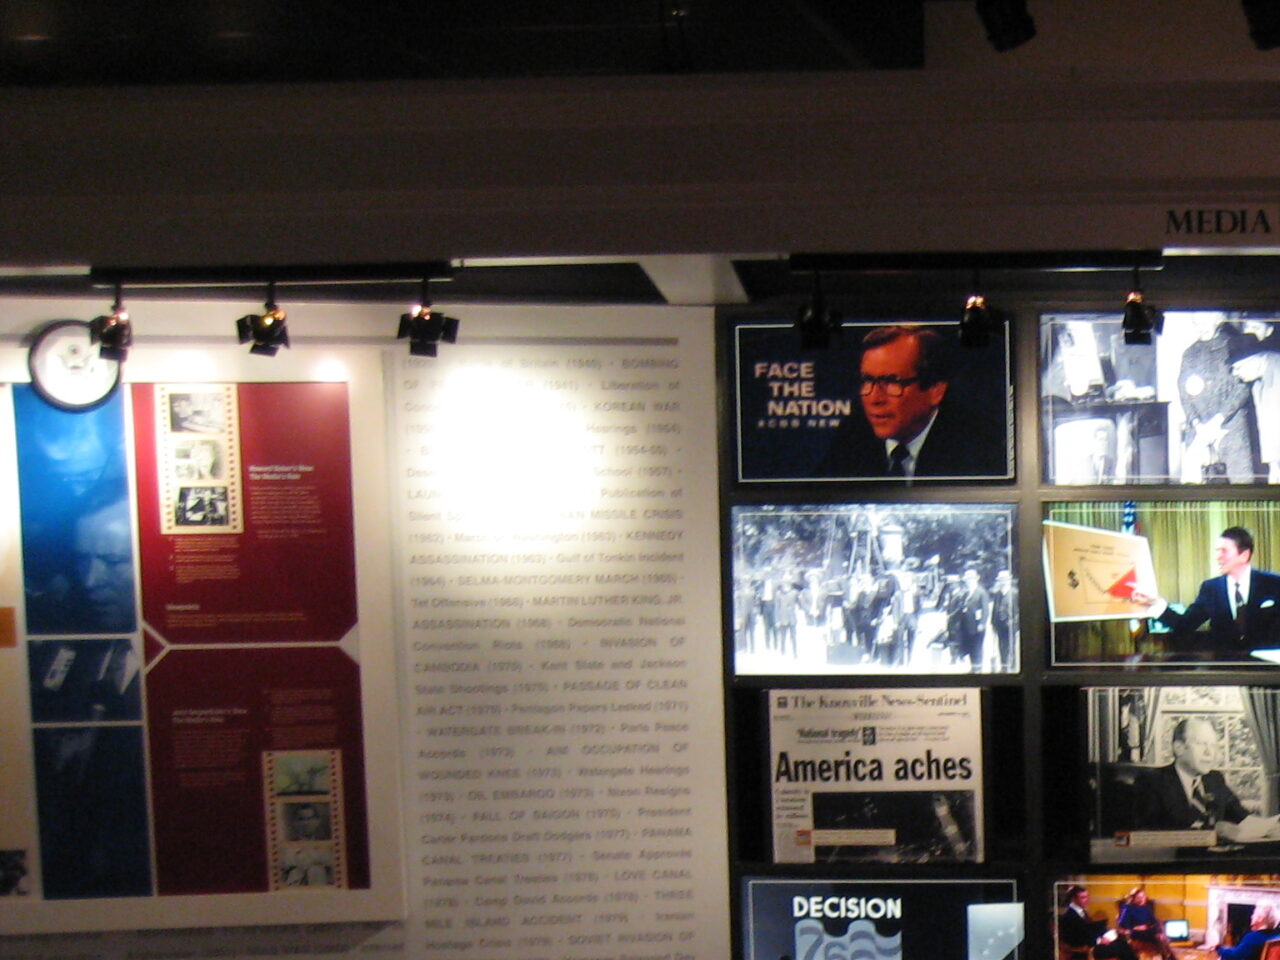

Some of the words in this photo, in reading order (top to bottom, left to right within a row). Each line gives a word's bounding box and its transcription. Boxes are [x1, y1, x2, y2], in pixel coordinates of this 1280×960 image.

[1165, 209, 1270, 235] MEDIA
[754, 363, 815, 378] FACE
[769, 381, 816, 397] THE
[767, 399, 851, 416] NATION
[776, 751, 883, 783] America
[894, 749, 972, 780] aches
[793, 896, 902, 918] DECISION
